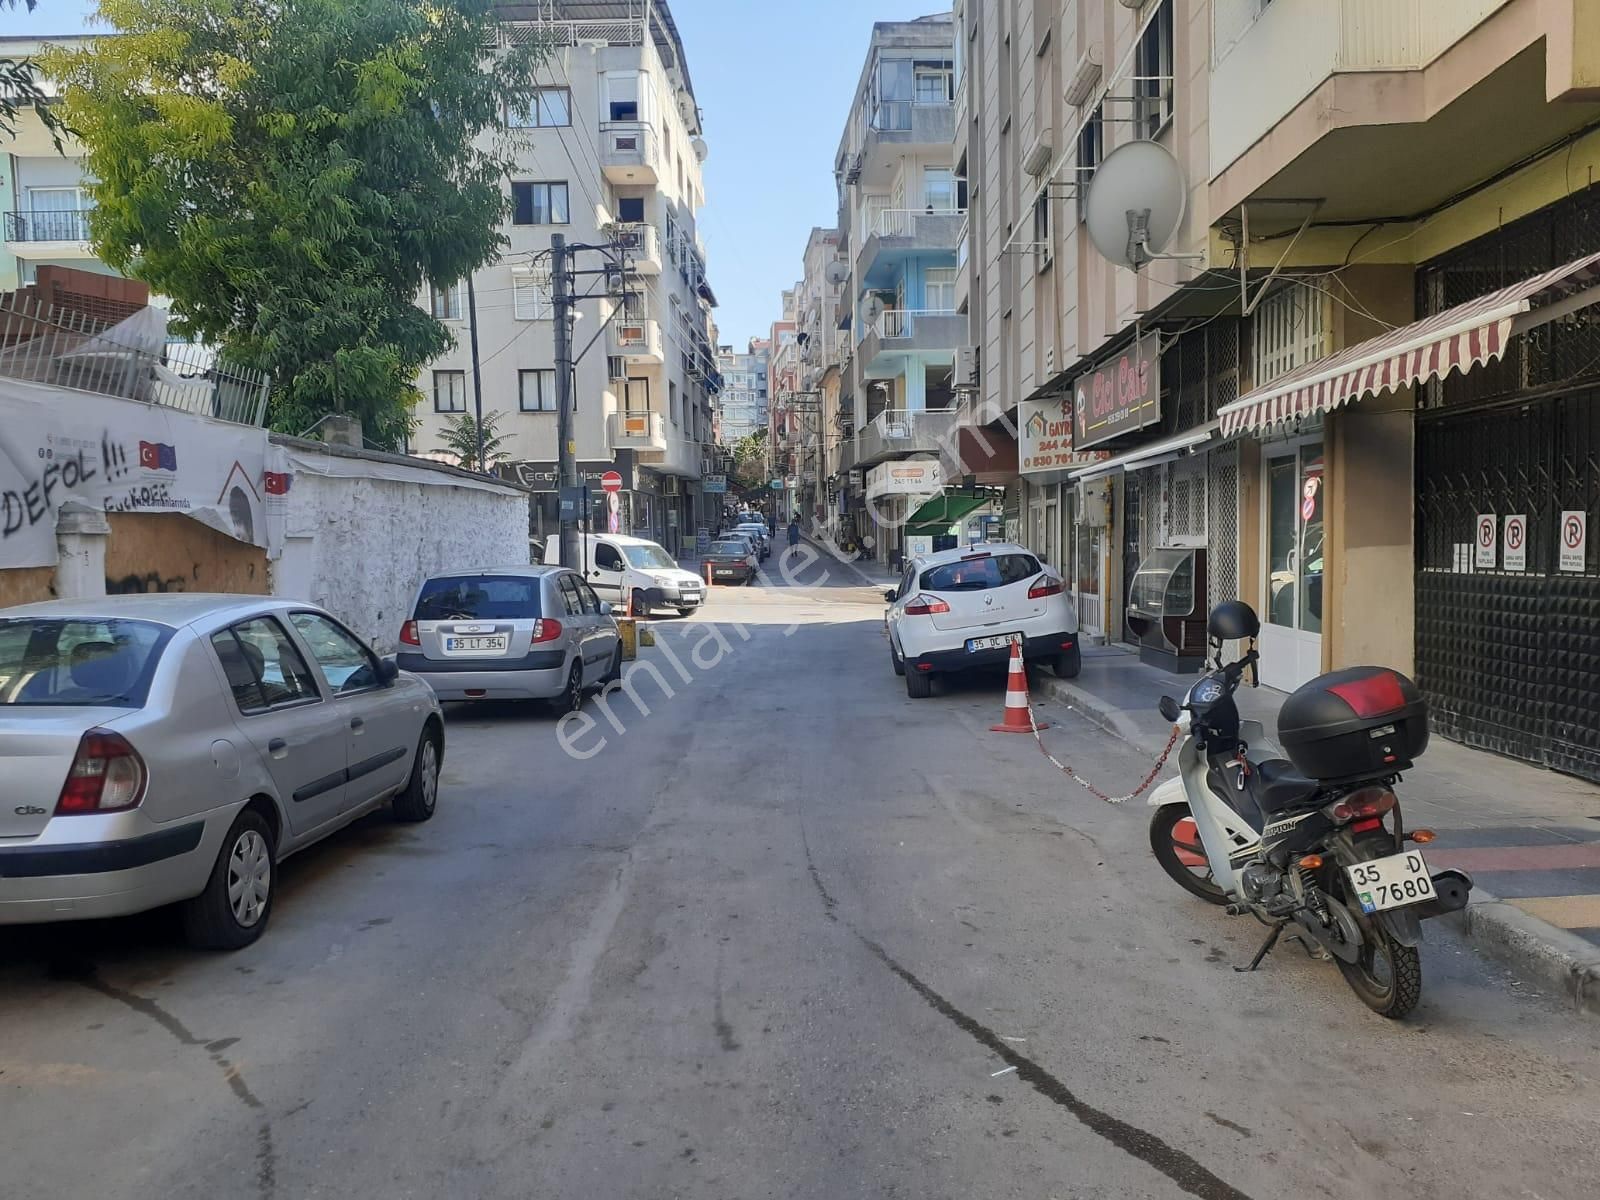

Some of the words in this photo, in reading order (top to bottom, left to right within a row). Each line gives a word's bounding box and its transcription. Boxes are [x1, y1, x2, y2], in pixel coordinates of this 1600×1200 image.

[1033, 455, 1052, 466] 530
[454, 639, 464, 649] 35
[470, 639, 481, 649] LT
[486, 638, 502, 648] 354
[974, 640, 984, 649] 35
[14, 806, 46, 816] Clio
[1353, 864, 1381, 886] 35
[1406, 855, 1421, 873] D
[1375, 877, 1430, 905] 7680
